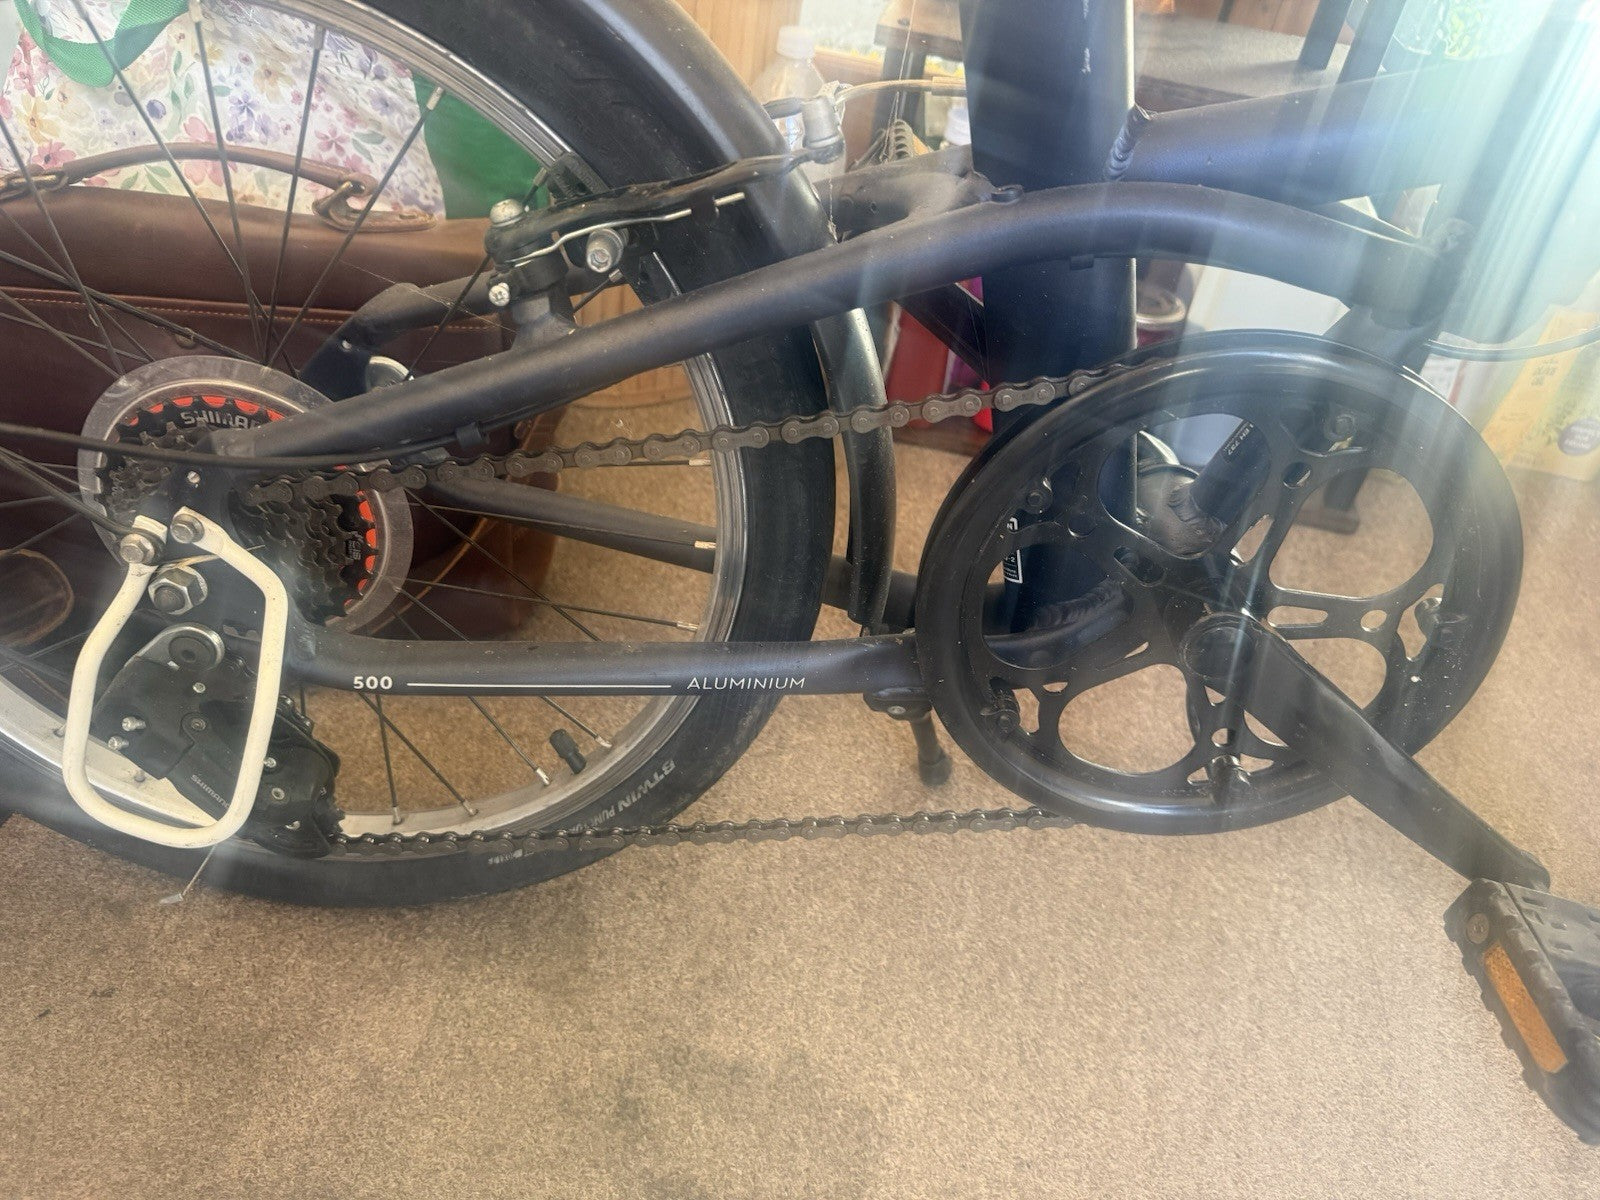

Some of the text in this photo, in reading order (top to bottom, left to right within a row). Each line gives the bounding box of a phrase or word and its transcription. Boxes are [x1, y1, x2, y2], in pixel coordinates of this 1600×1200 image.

[180, 410, 254, 429] SHIMA
[353, 675, 806, 690] 500 ALUMINIUM
